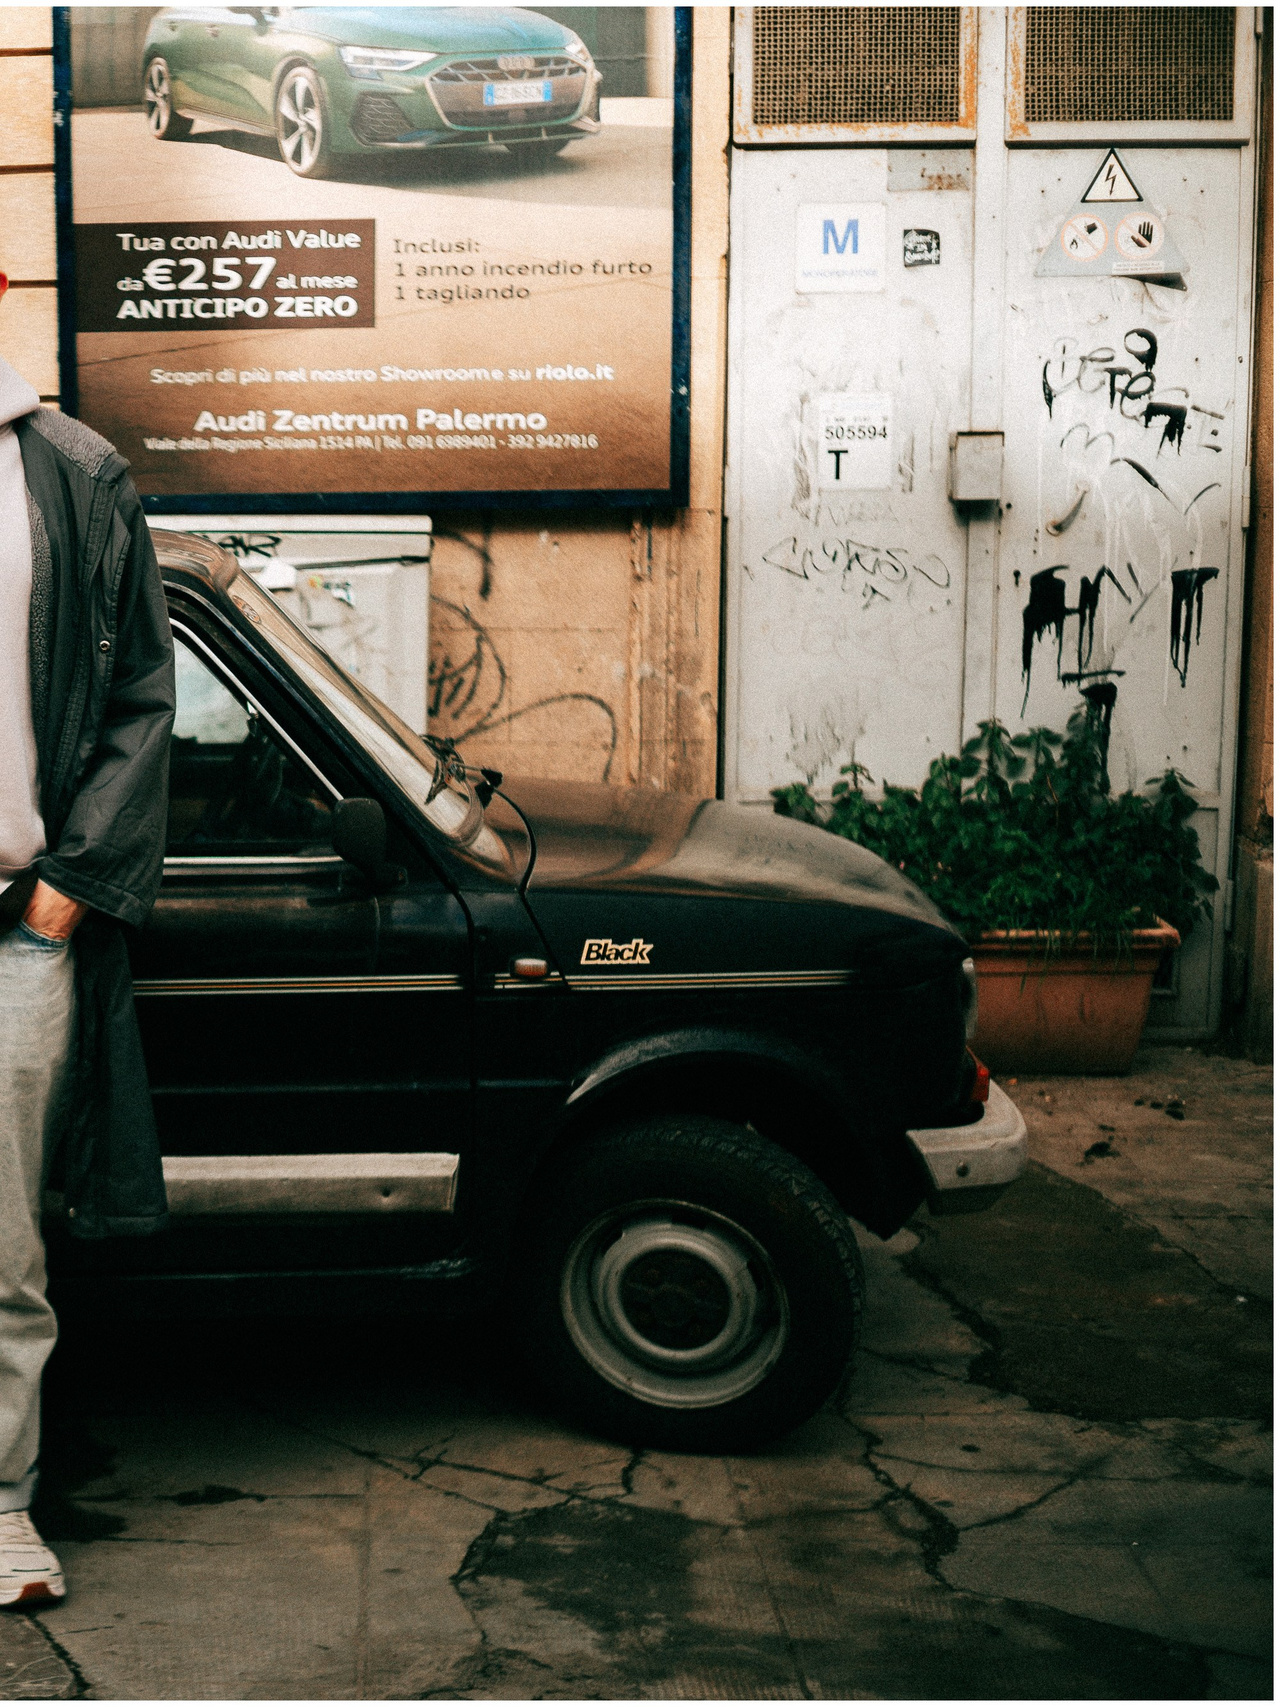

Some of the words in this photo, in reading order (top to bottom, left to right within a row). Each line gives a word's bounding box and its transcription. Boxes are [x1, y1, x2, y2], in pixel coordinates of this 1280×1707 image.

[116, 233, 166, 250] Tua
[170, 235, 218, 250] con
[221, 230, 282, 249] Audi
[285, 229, 362, 249] Value
[393, 238, 480, 254] Inclusi:
[822, 219, 859, 254] M
[116, 276, 144, 291] da
[142, 256, 277, 291] €257
[275, 273, 298, 290] al
[300, 274, 359, 290] mese
[395, 263, 406, 277] 1
[416, 264, 475, 277] anno
[482, 260, 584, 276] incendio
[592, 259, 653, 275] furto
[395, 286, 406, 300] 1
[416, 284, 531, 305] tagliando
[116, 297, 270, 319] ANTICIPO
[273, 295, 359, 318] ZERO
[149, 368, 214, 386] Scopri
[215, 367, 237, 384] di
[239, 367, 271, 386] più
[274, 367, 308, 384] nel
[310, 367, 378, 383] nostro
[507, 368, 532, 382] su
[535, 363, 614, 382] riolo.it
[193, 409, 266, 432] Audi
[271, 408, 409, 432] Zentrum
[416, 408, 548, 431] Palermo
[143, 437, 177, 450] Viale
[177, 436, 211, 450] della
[211, 436, 264, 453] Regione
[263, 436, 318, 450] Siciliana
[407, 434, 434, 449] 091
[507, 434, 534, 449] 392
[825, 425, 888, 440] 505594
[828, 450, 848, 480] T
[583, 940, 650, 963] Black
